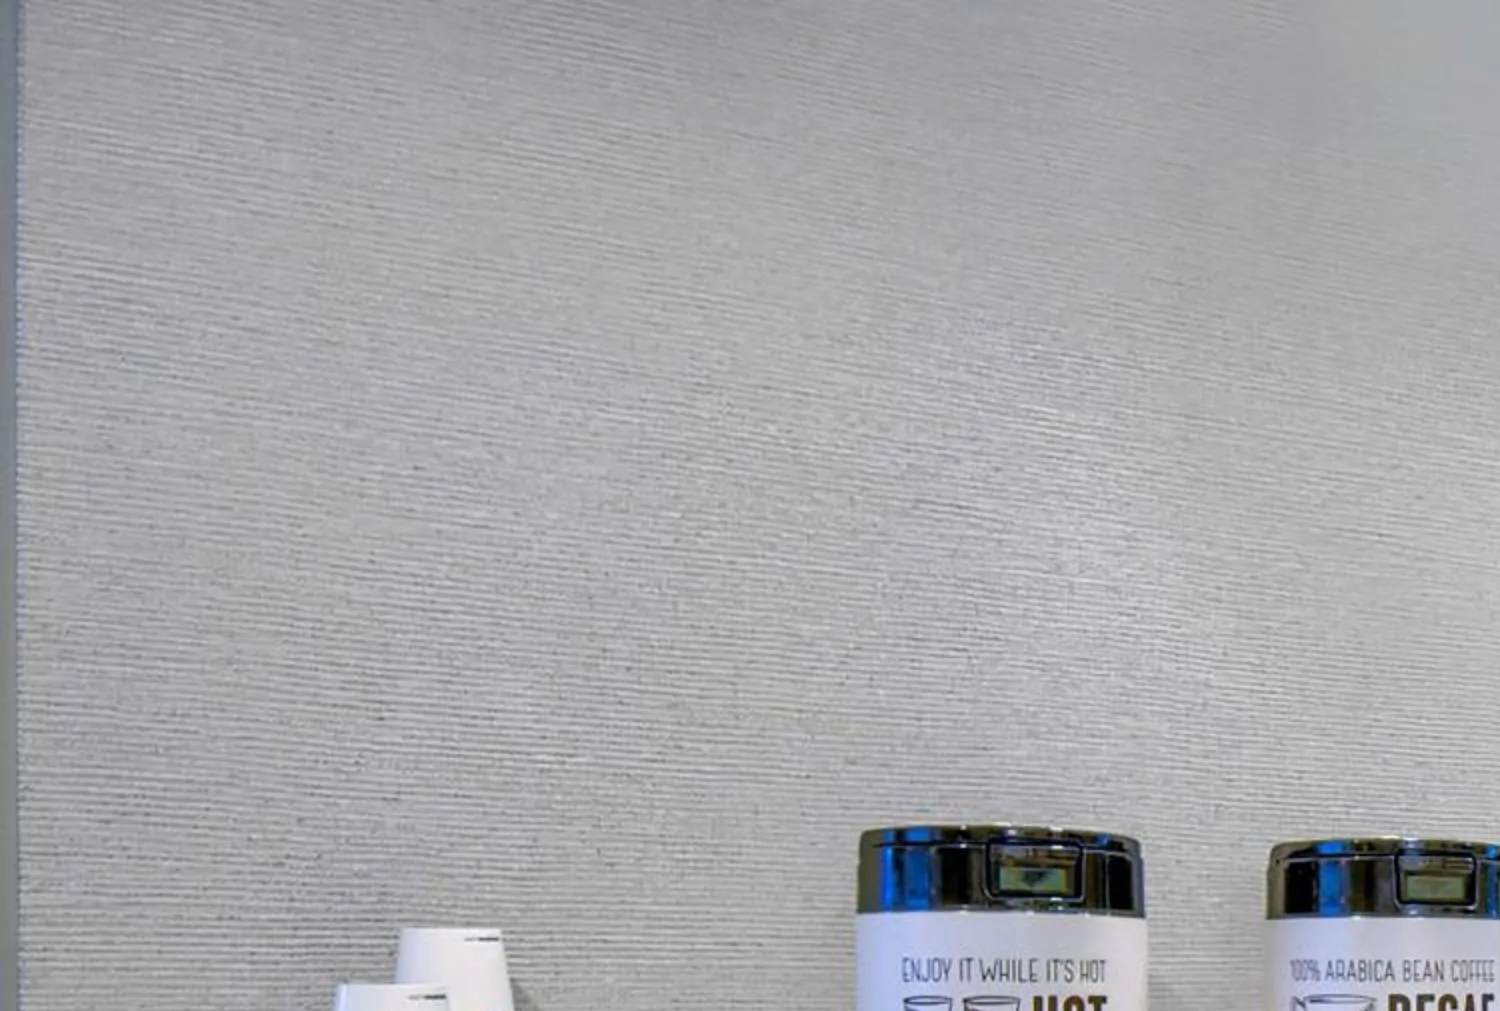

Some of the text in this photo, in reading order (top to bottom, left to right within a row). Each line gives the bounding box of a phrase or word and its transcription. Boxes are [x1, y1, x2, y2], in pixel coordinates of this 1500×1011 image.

[902, 957, 1107, 983] ENJOY IT WHILE IT'S HOT
[1290, 960, 1495, 982] 100% ARABICA BEAN COFFEE
